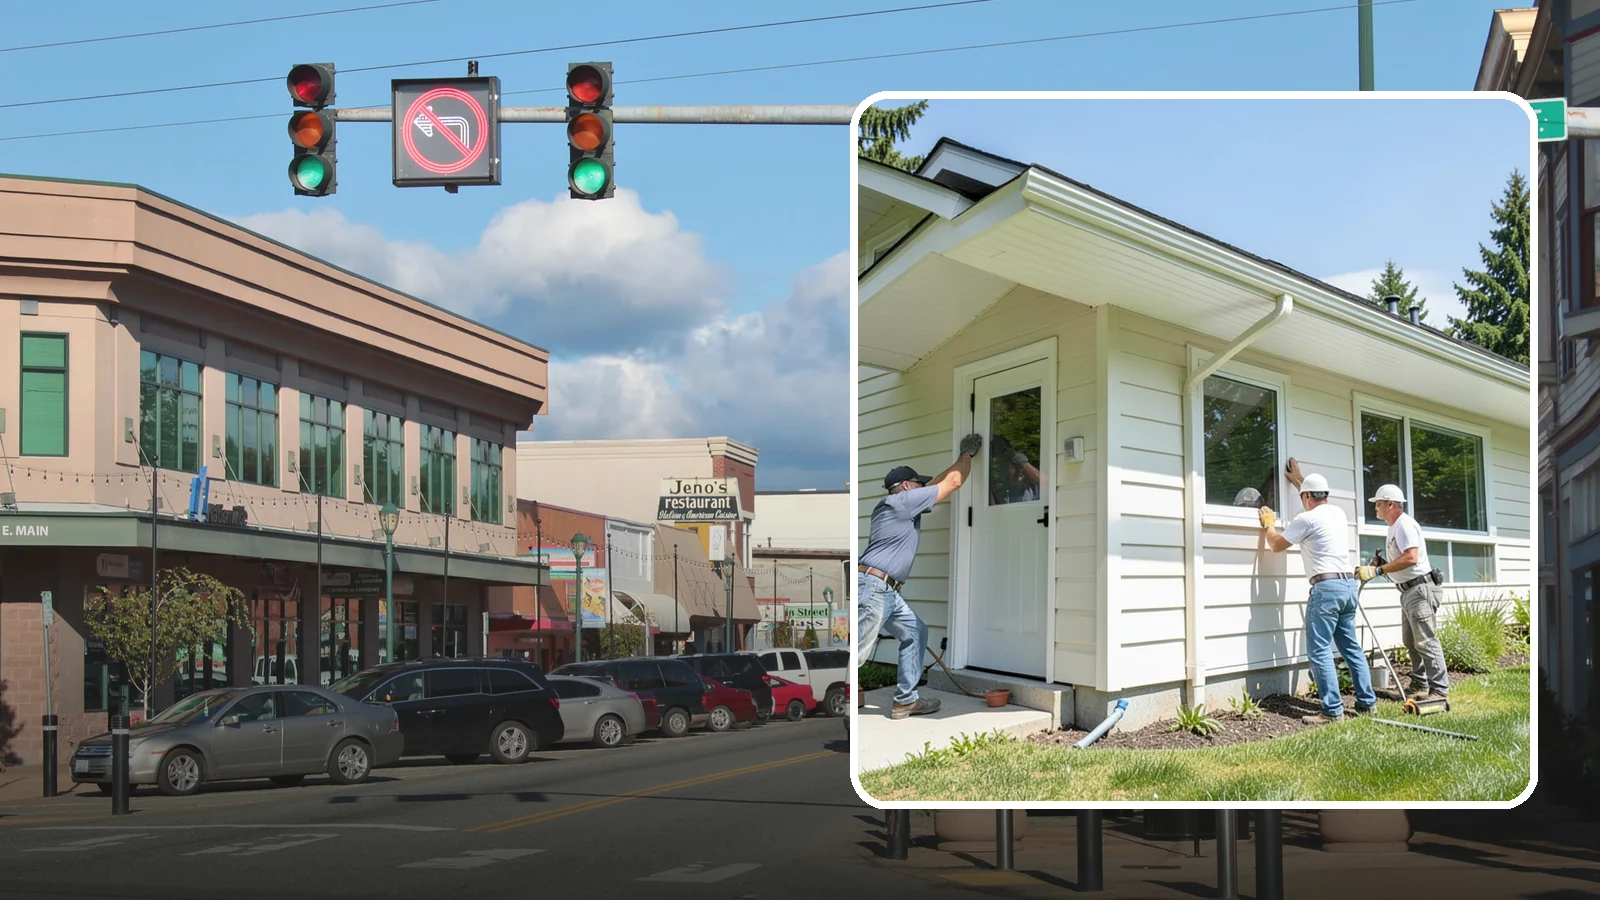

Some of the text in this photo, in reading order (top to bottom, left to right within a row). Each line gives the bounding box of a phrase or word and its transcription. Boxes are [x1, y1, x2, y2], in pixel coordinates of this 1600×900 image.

[670, 480, 728, 494] Jeno's
[665, 496, 731, 509] restaurant
[658, 509, 681, 519] Italian
[686, 509, 714, 519] American
[715, 509, 738, 519] Cuisine
[2, 525, 49, 536] E. MAIN
[785, 607, 828, 617] in Street
